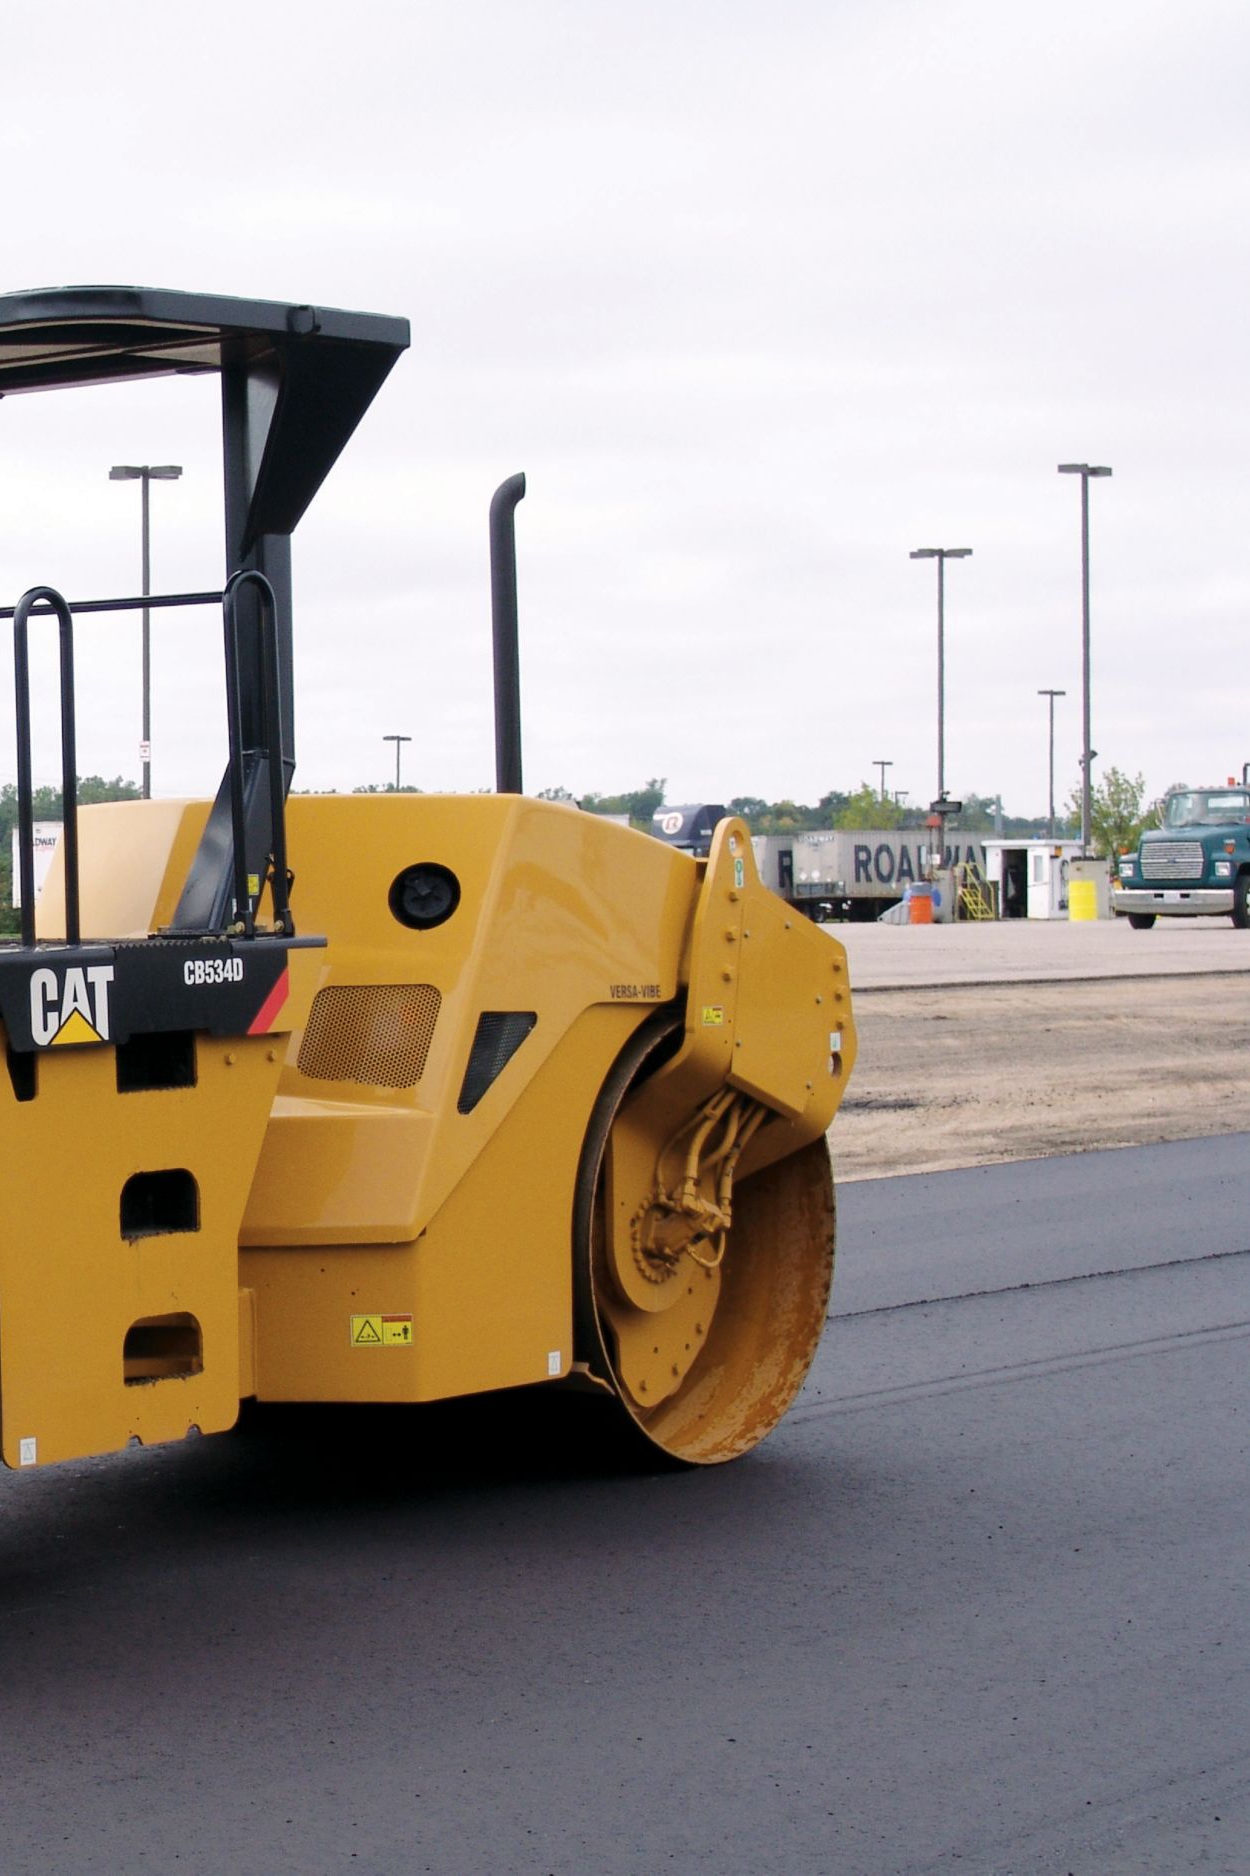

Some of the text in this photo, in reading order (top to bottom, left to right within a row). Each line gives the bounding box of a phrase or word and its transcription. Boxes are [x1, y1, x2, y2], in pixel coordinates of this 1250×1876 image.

[33, 837, 56, 847] DWAY
[184, 958, 243, 985] CB534D
[610, 984, 662, 999] VERSA-VIBE
[30, 965, 114, 1046] CAT
